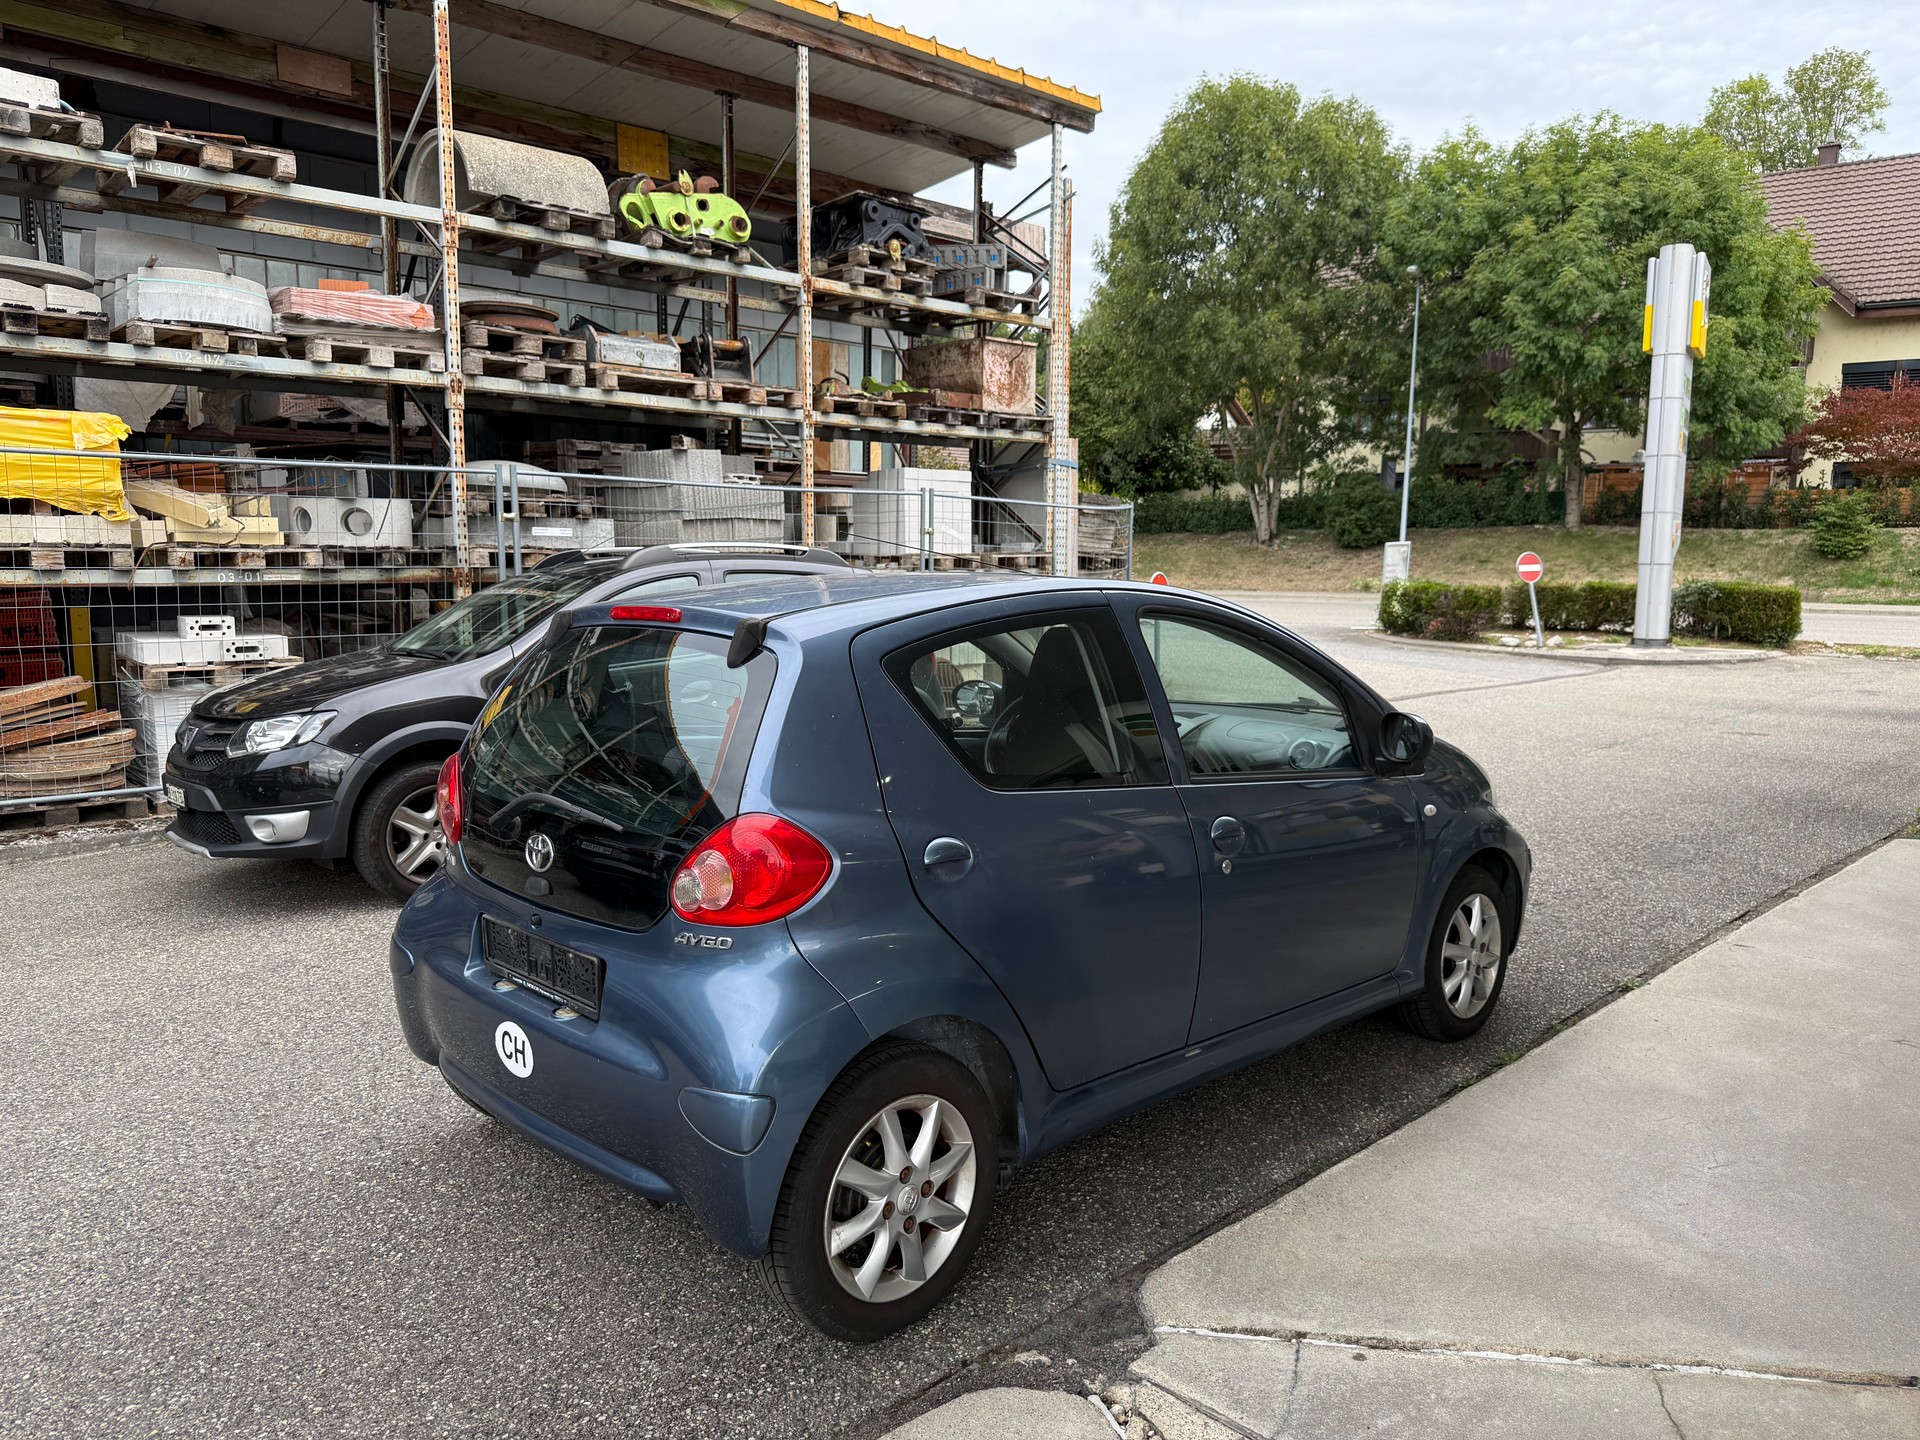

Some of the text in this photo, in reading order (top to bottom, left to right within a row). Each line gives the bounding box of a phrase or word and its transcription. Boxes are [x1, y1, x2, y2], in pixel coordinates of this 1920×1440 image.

[145, 160, 191, 178] 03-07
[217, 572, 261, 583] 03-01
[673, 932, 734, 950] AYGO
[501, 1030, 527, 1069] CH
